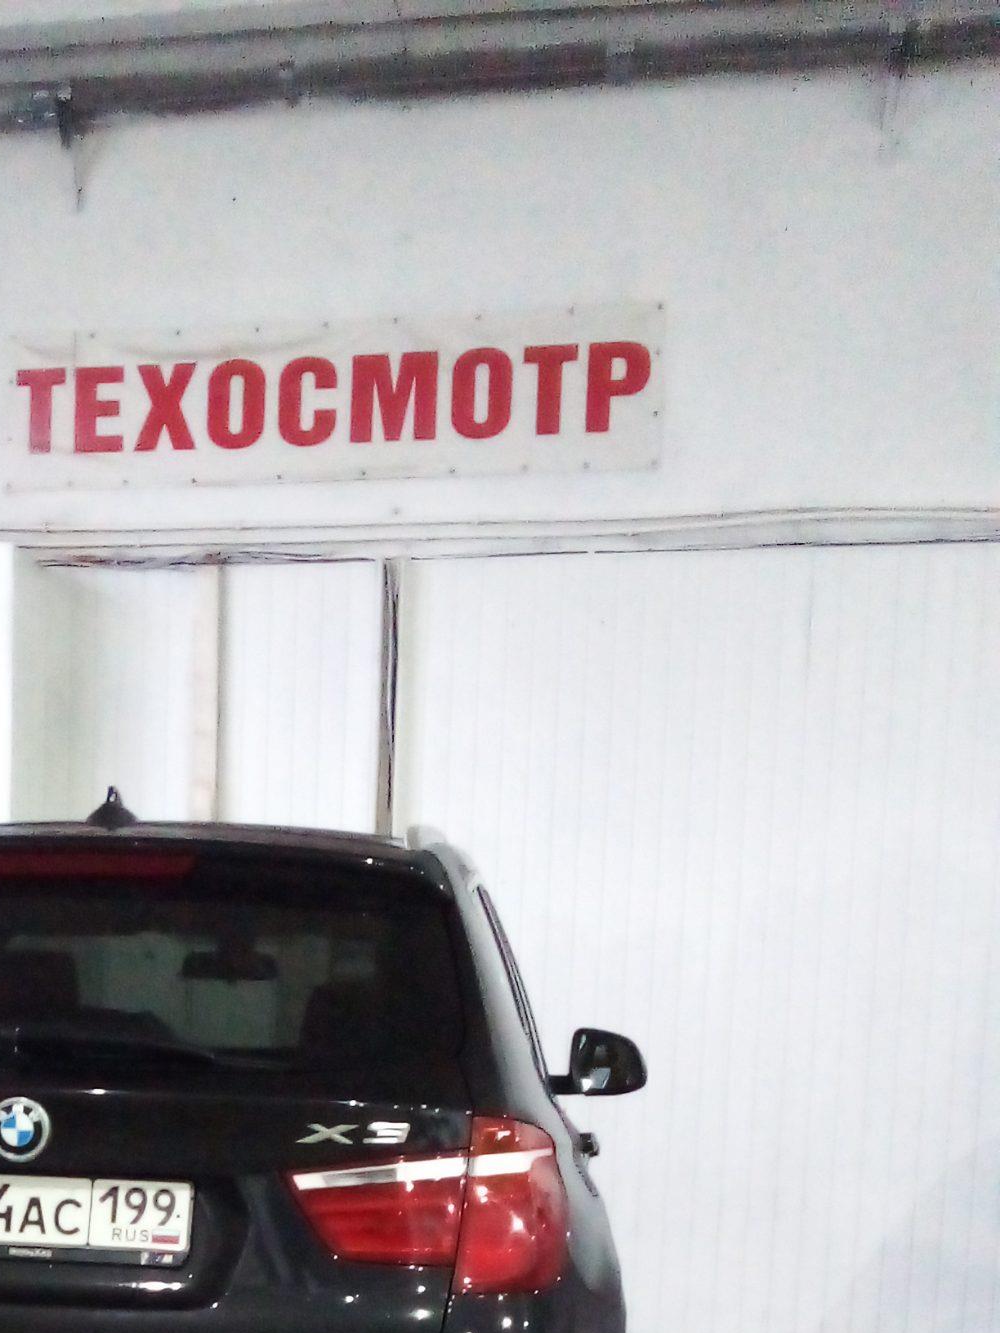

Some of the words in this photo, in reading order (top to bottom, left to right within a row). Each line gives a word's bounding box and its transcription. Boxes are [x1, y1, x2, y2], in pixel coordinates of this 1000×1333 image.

[16, 341, 652, 454] ТЕХОСМОТР
[295, 1121, 411, 1145] X3
[99, 1186, 177, 1226] 199
[111, 1227, 150, 1242] RUS
